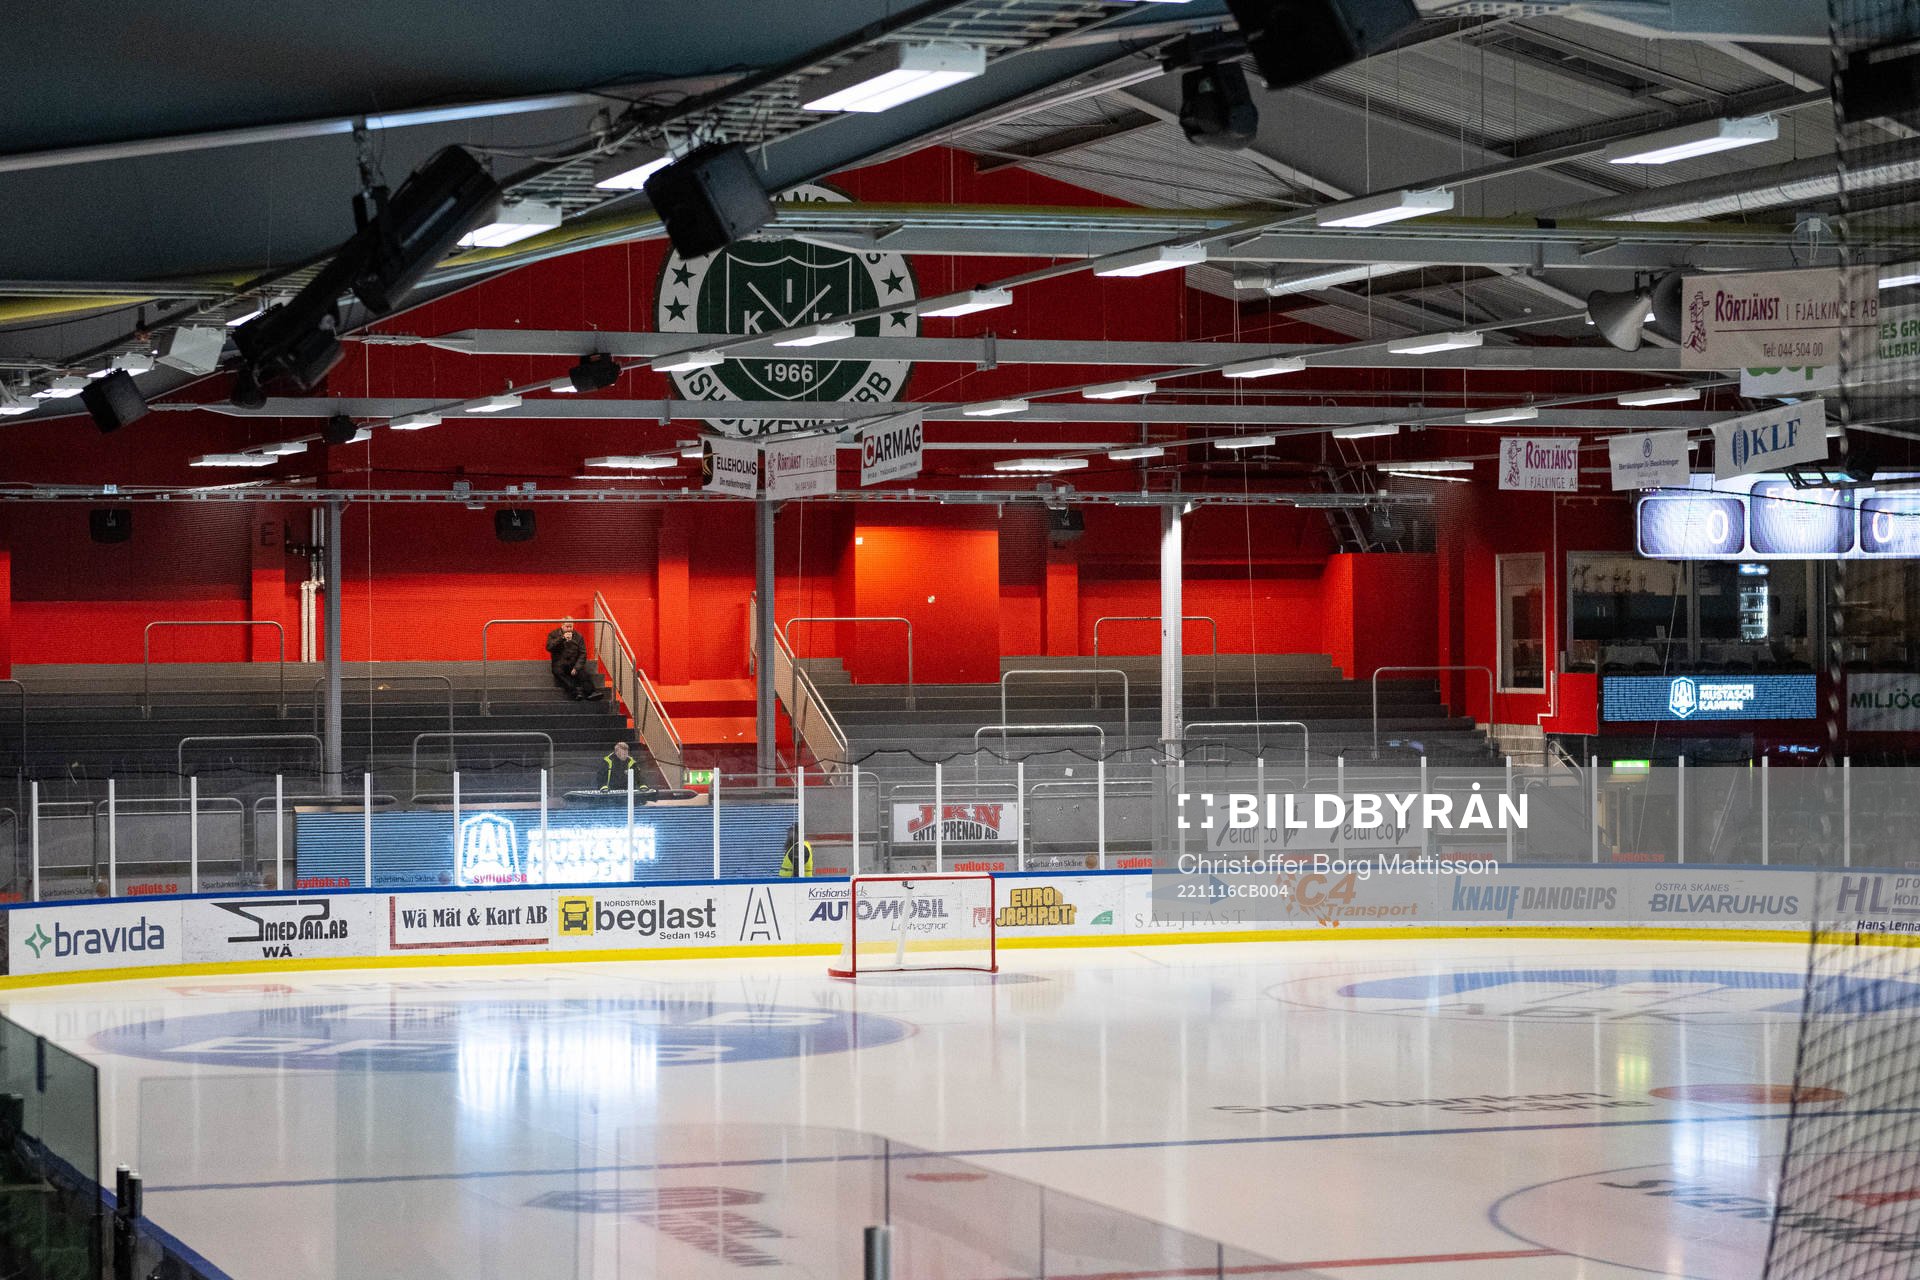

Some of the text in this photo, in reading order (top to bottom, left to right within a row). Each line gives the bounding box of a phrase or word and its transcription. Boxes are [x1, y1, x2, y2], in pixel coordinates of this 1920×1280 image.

[1715, 290, 1780, 322] RÖRTJÄNST
[1861, 299, 1878, 318] AB
[1880, 322, 1898, 340] ES
[1777, 342, 1811, 358] 044-504
[1812, 341, 1824, 357] 00
[763, 363, 815, 383] 1966
[863, 423, 921, 470] CARMAG
[1750, 417, 1801, 457] KLF
[1525, 440, 1577, 470] RÖRTJÄNST
[716, 456, 757, 476] ELLEHOLMS
[1706, 509, 1729, 545] 0
[907, 803, 1004, 833] JKN
[912, 820, 999, 841] ENTRPRENAD AB
[808, 885, 868, 898] Kristianstds
[1010, 886, 1056, 907] EURO
[1295, 873, 1357, 907] C4
[1654, 882, 1730, 892] ÖSTRA SKÅNES
[1836, 876, 1890, 914] HL
[604, 899, 657, 907] NORDSTRÖMS
[1521, 886, 1618, 911] DANOGIPS
[1649, 893, 1799, 915] BILVARUHUS
[1893, 892, 1920, 906] kon
[402, 905, 549, 929] Wä Mät & Kart AB
[596, 898, 717, 936] beglast
[1325, 902, 1418, 919] Transport
[659, 930, 717, 940] Sedan 1945
[1857, 920, 1885, 931] Hans
[54, 916, 165, 957] bravida
[262, 944, 293, 958] WÄ
[162, 1037, 737, 1061] BFB
[1211, 1092, 1613, 1114] Sparbanken
[1440, 1100, 1656, 1114] Skåne
